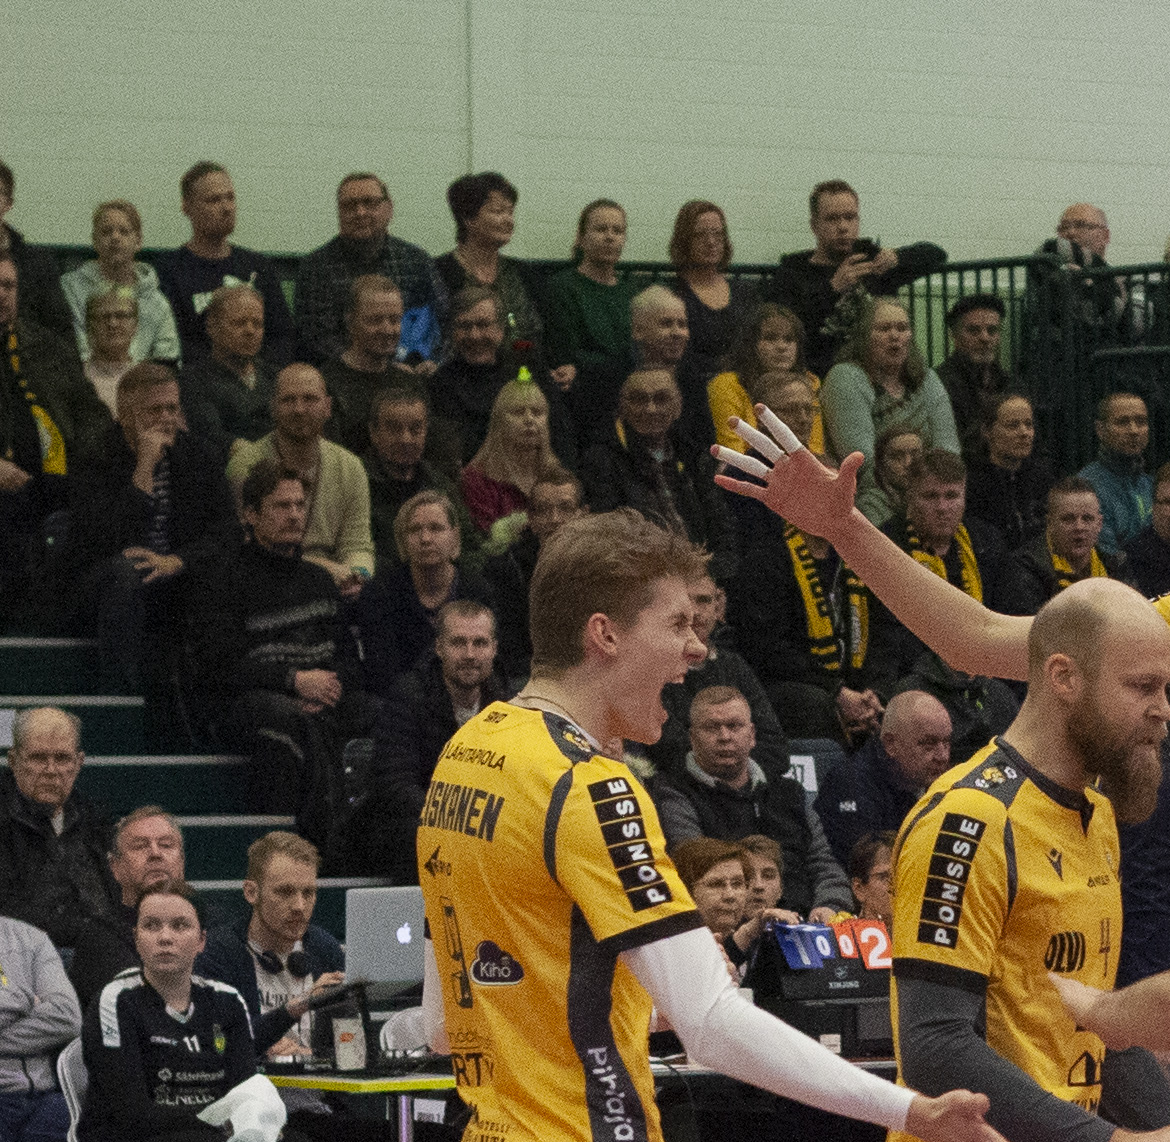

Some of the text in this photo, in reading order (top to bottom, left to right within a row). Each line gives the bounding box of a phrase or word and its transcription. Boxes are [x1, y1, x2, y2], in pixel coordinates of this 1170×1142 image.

[606, 777, 668, 904] PONSSE
[934, 817, 981, 946] PONSSE
[859, 926, 893, 968] 2
